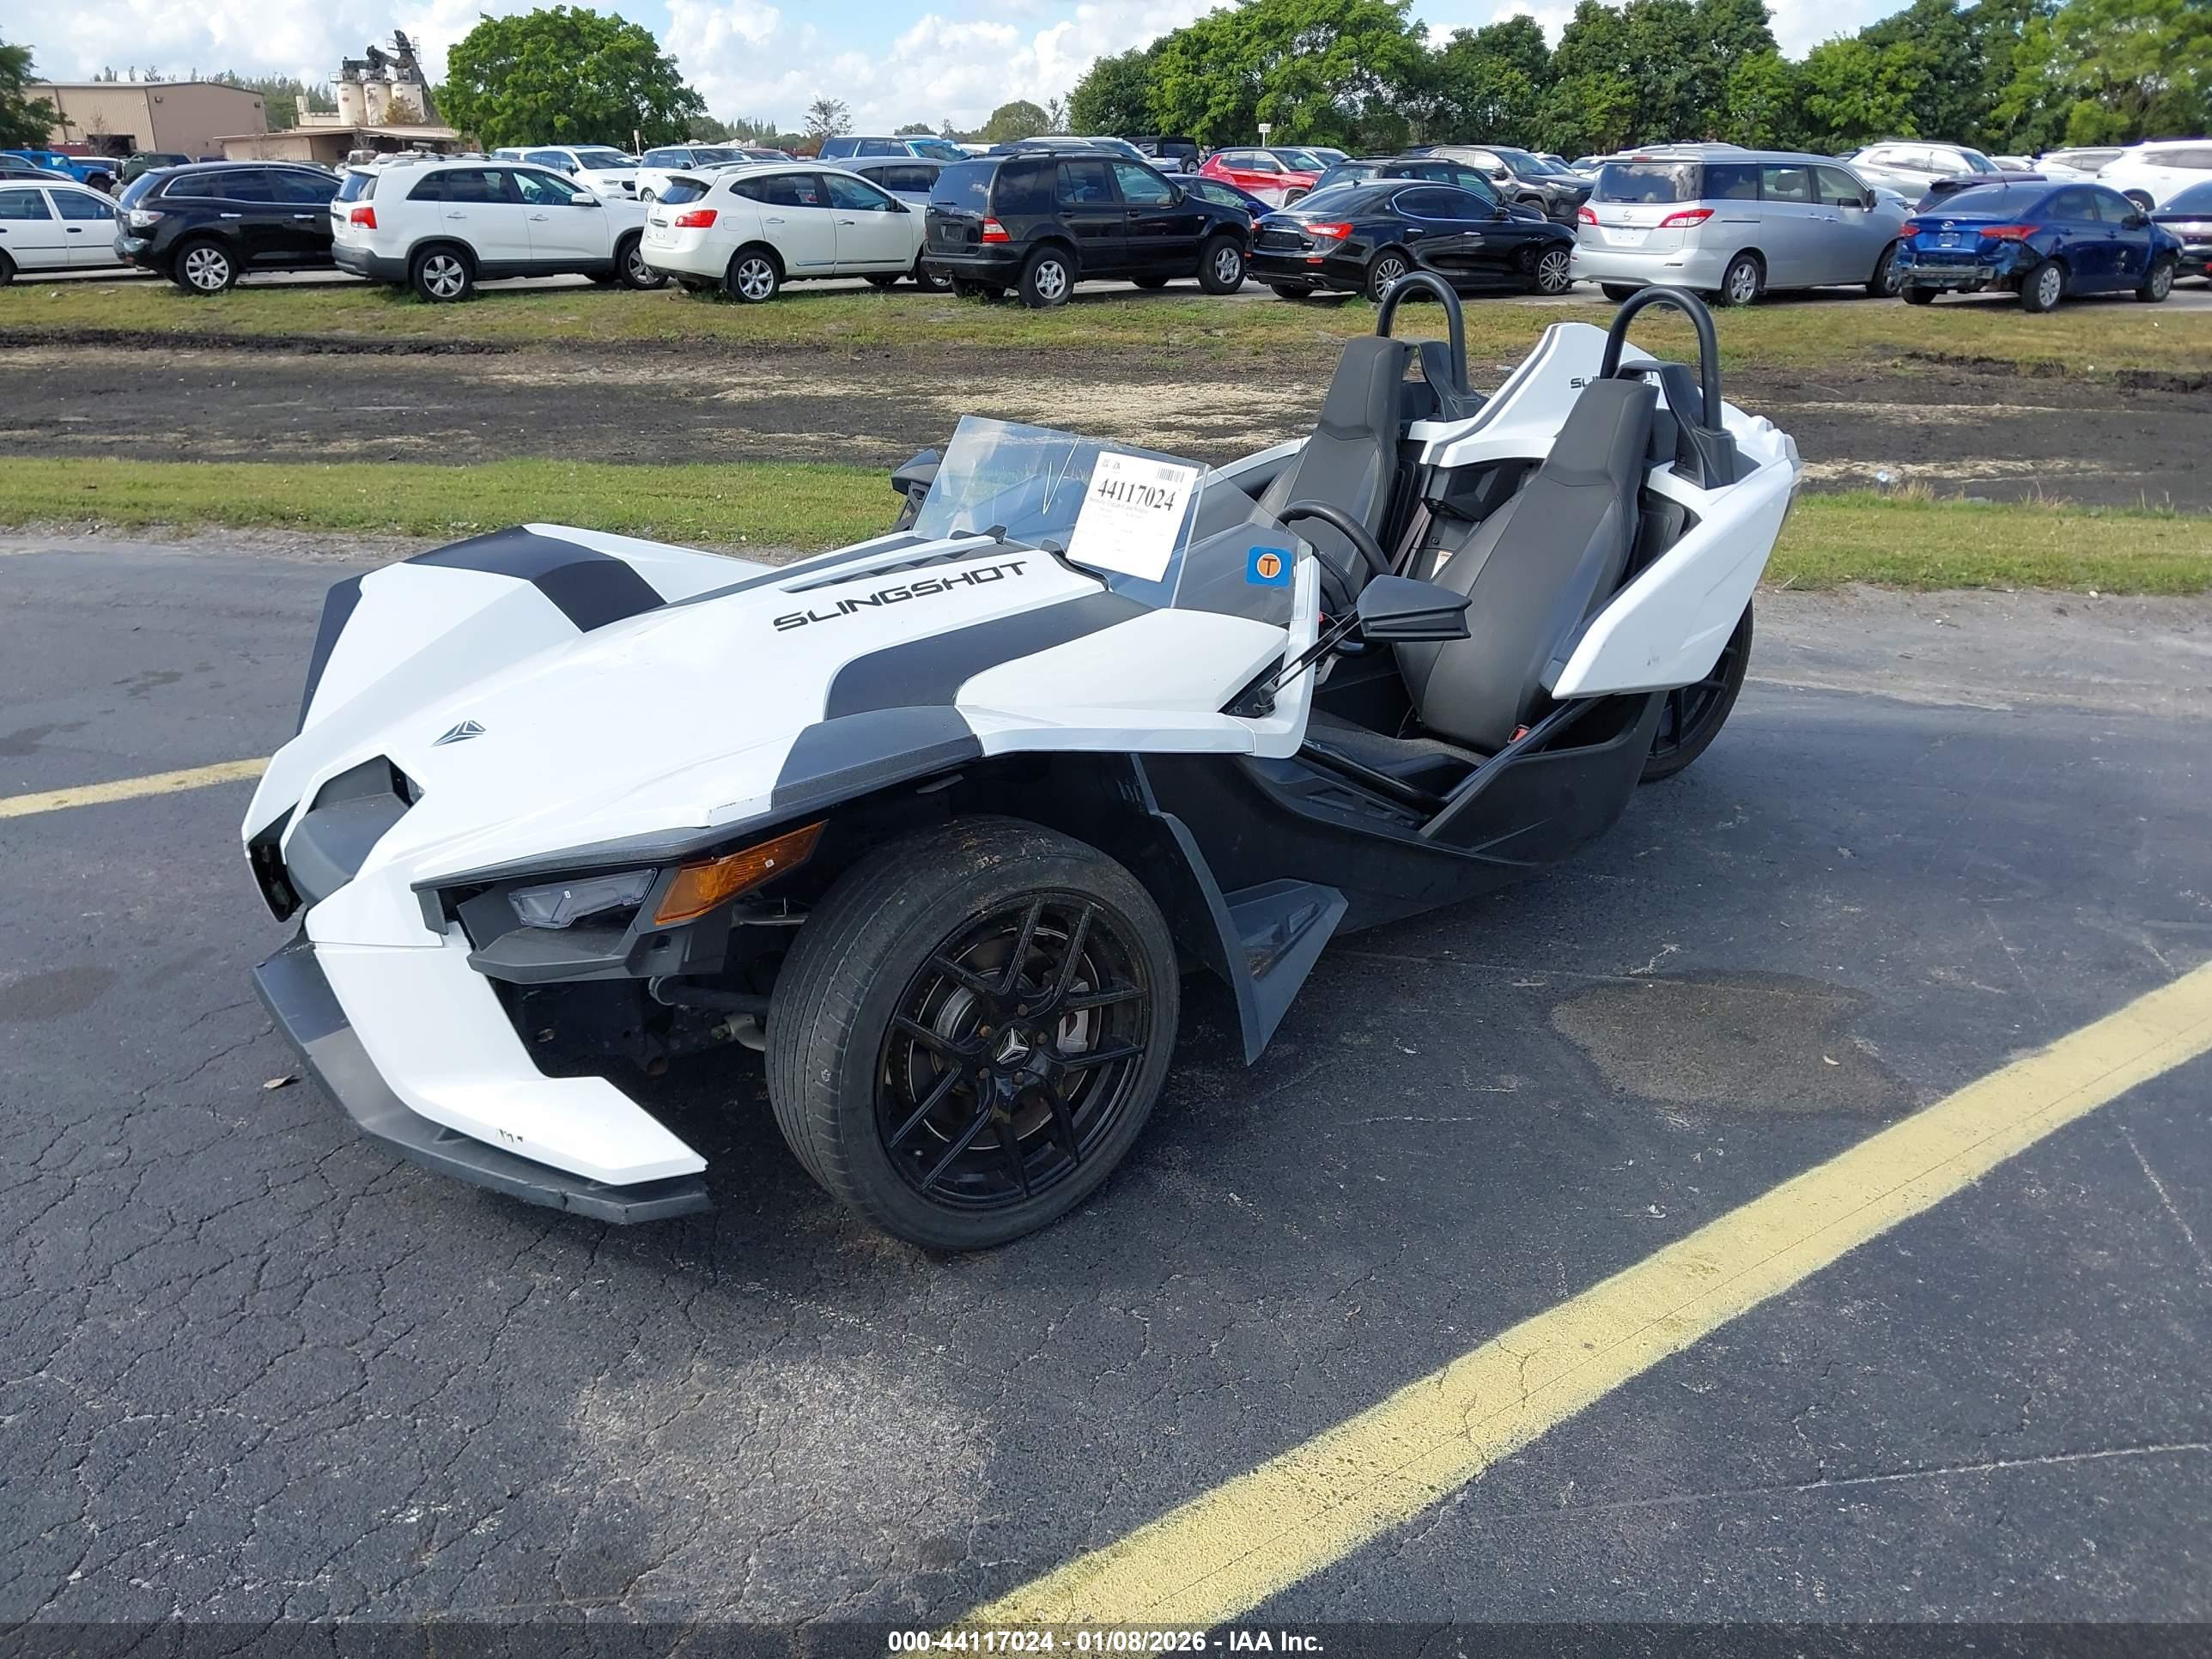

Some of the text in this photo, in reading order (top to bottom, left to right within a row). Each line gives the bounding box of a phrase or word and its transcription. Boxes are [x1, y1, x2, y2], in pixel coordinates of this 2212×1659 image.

[1097, 478, 1176, 511] 44117024
[1263, 557, 1277, 576] T
[773, 561, 1028, 632] SLINGSHOT
